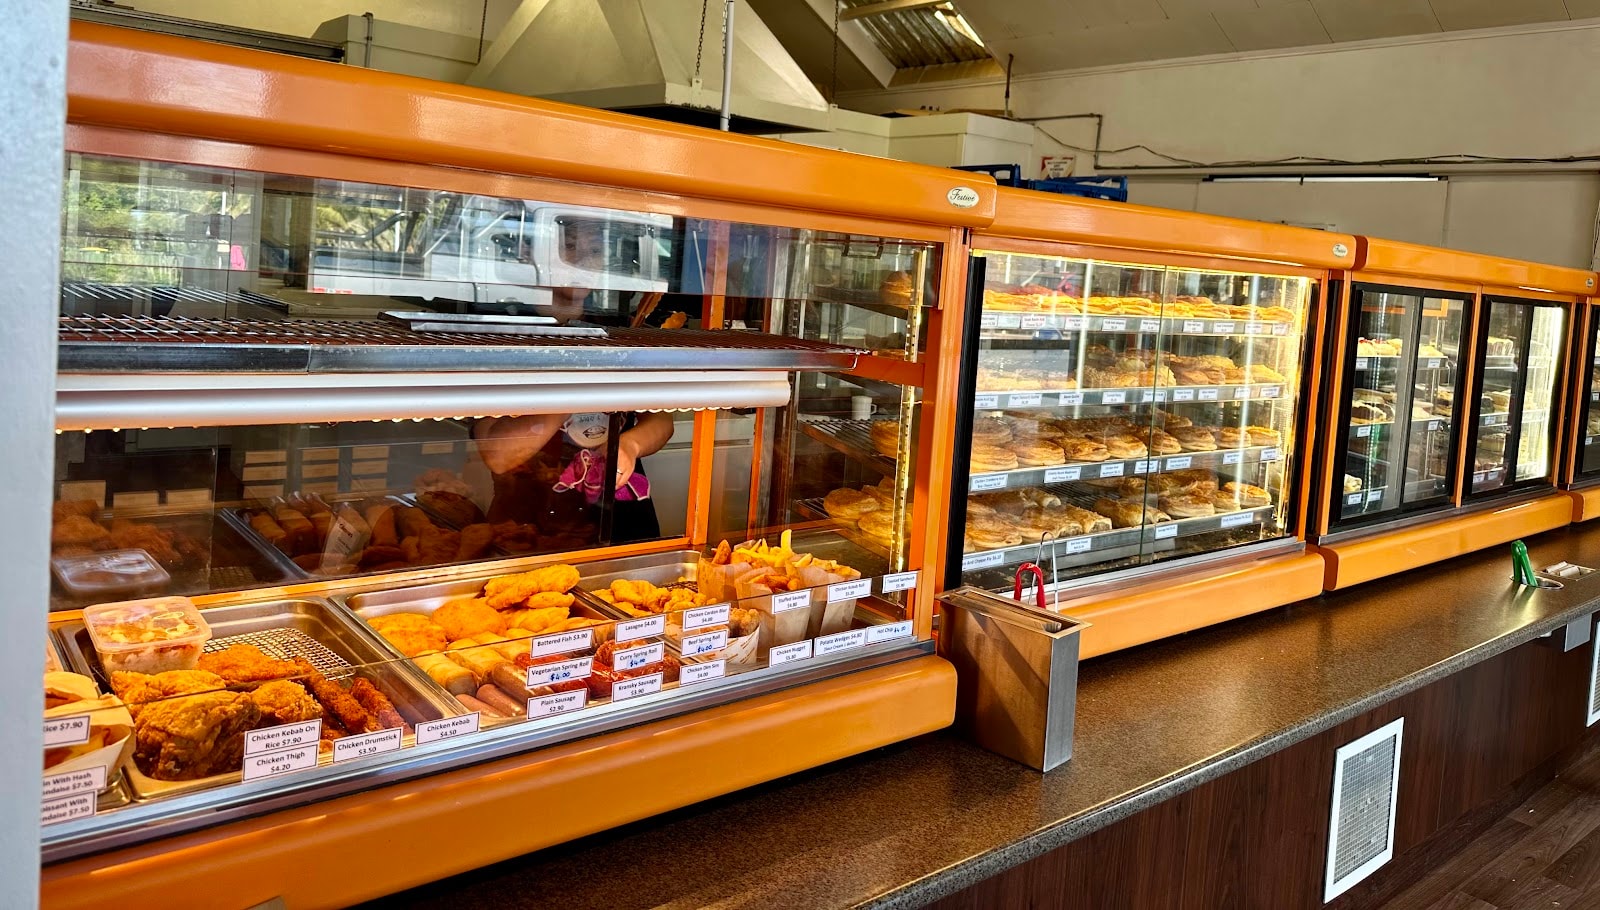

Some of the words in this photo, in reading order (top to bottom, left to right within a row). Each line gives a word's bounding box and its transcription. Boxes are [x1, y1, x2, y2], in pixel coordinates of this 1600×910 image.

[537, 638, 560, 647] Battered
[531, 666, 561, 676] Vegetarian
[618, 682, 637, 691] Kransky
[638, 678, 657, 687] Sausage
[60, 721, 82, 730] $7.90
[427, 723, 450, 732] Chicken
[451, 718, 470, 726] Kebab
[252, 732, 280, 742] Chicken
[282, 728, 303, 736] Kebab
[282, 737, 301, 746] $7.90
[338, 741, 364, 751] Chicken
[365, 734, 397, 745] Drumstick
[358, 747, 376, 755] $3.50
[257, 756, 284, 766] Chicken
[286, 752, 305, 761] Thigh
[271, 764, 290, 772] $4.20
[53, 775, 71, 785] With
[73, 773, 91, 781] Hash
[72, 781, 93, 790] $7.50
[69, 798, 88, 807] With
[69, 806, 89, 816] $7.50
